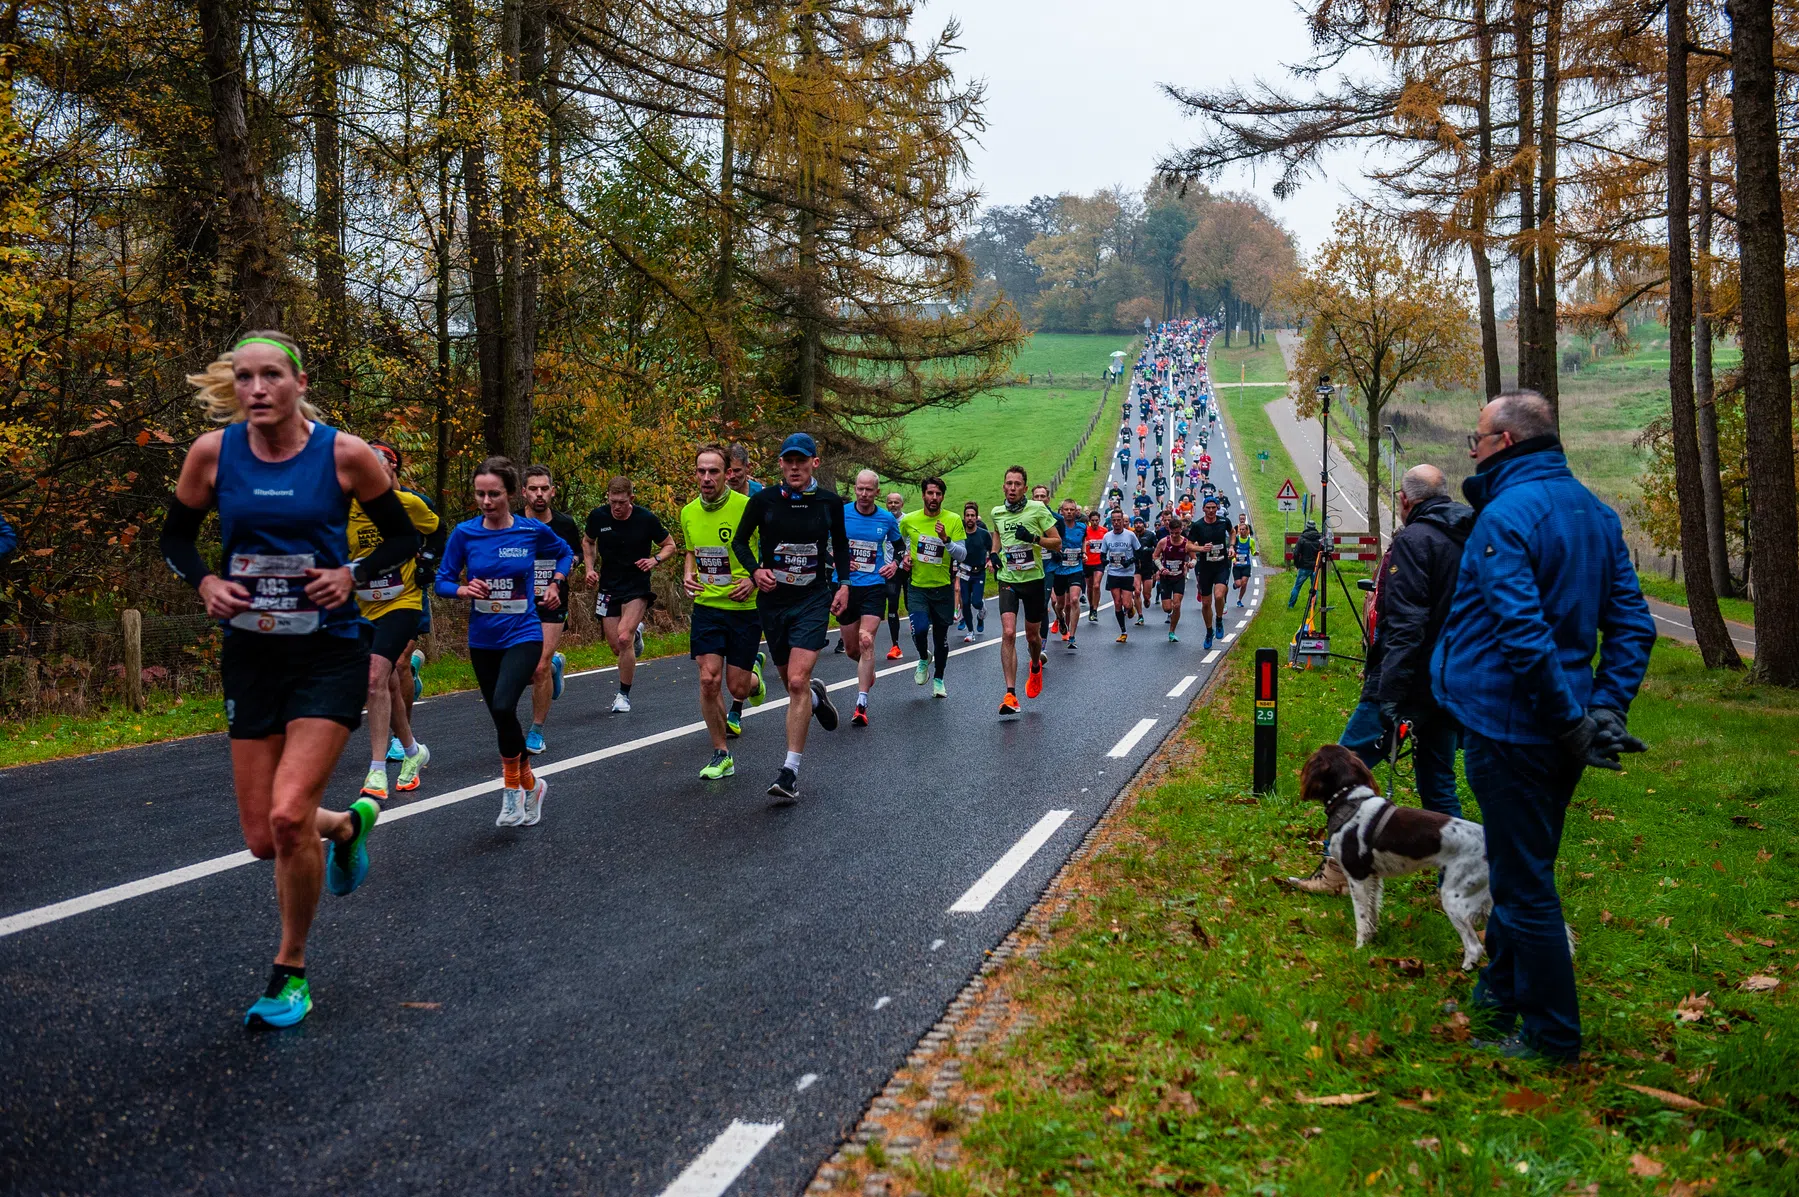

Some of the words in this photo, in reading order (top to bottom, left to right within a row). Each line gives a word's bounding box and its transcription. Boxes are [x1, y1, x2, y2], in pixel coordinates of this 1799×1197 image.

[784, 555, 808, 566] 5460
[256, 578, 289, 596] 483
[485, 578, 514, 591] 5485
[1257, 710, 1274, 721] 2,9
